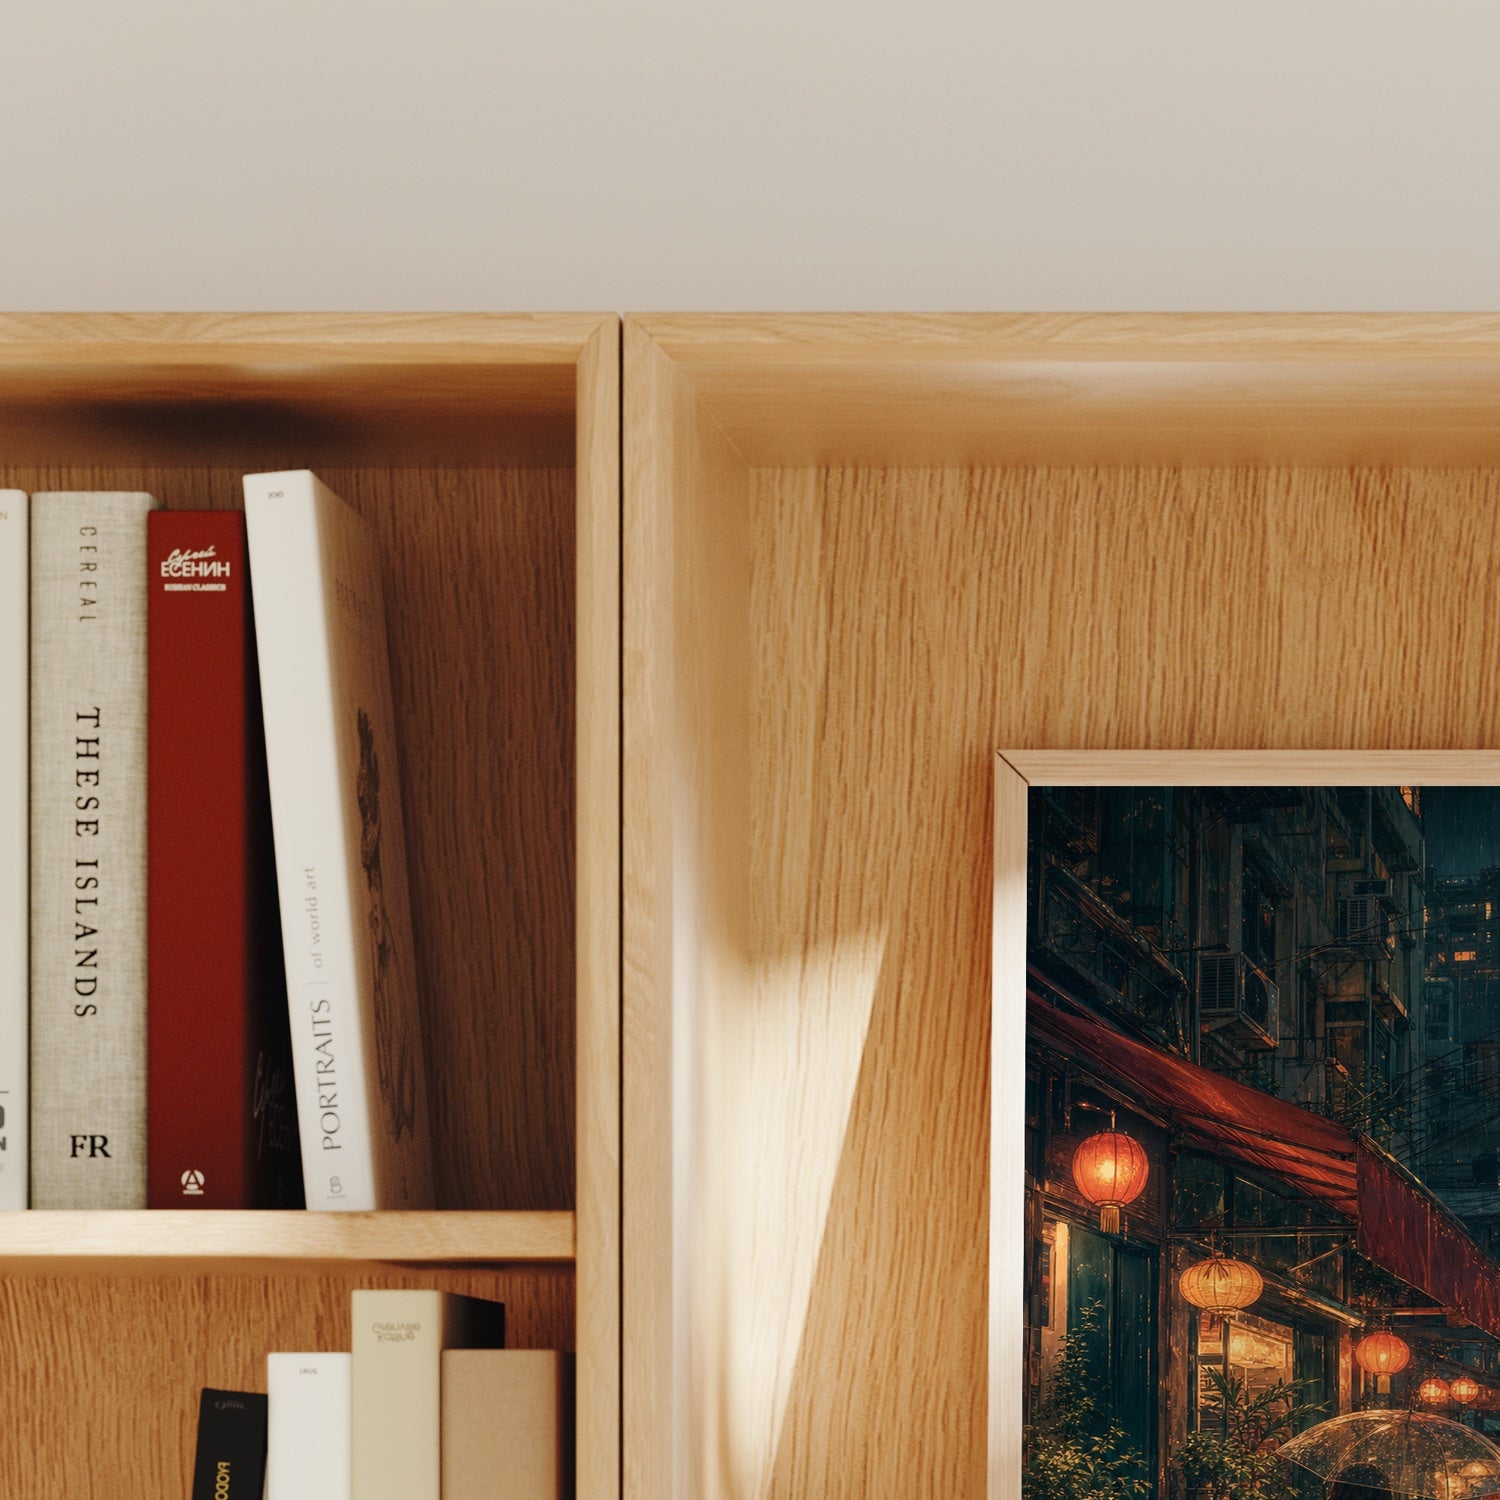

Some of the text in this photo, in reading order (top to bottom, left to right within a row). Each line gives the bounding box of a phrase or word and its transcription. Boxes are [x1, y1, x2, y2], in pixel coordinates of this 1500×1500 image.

[79, 525, 98, 623] CEREAL
[160, 560, 231, 578] ЕСЕНИН
[74, 707, 101, 1018] THESE ISLANDS
[304, 866, 342, 1152] PORTRAITS of world art
[70, 1134, 112, 1159] FR
